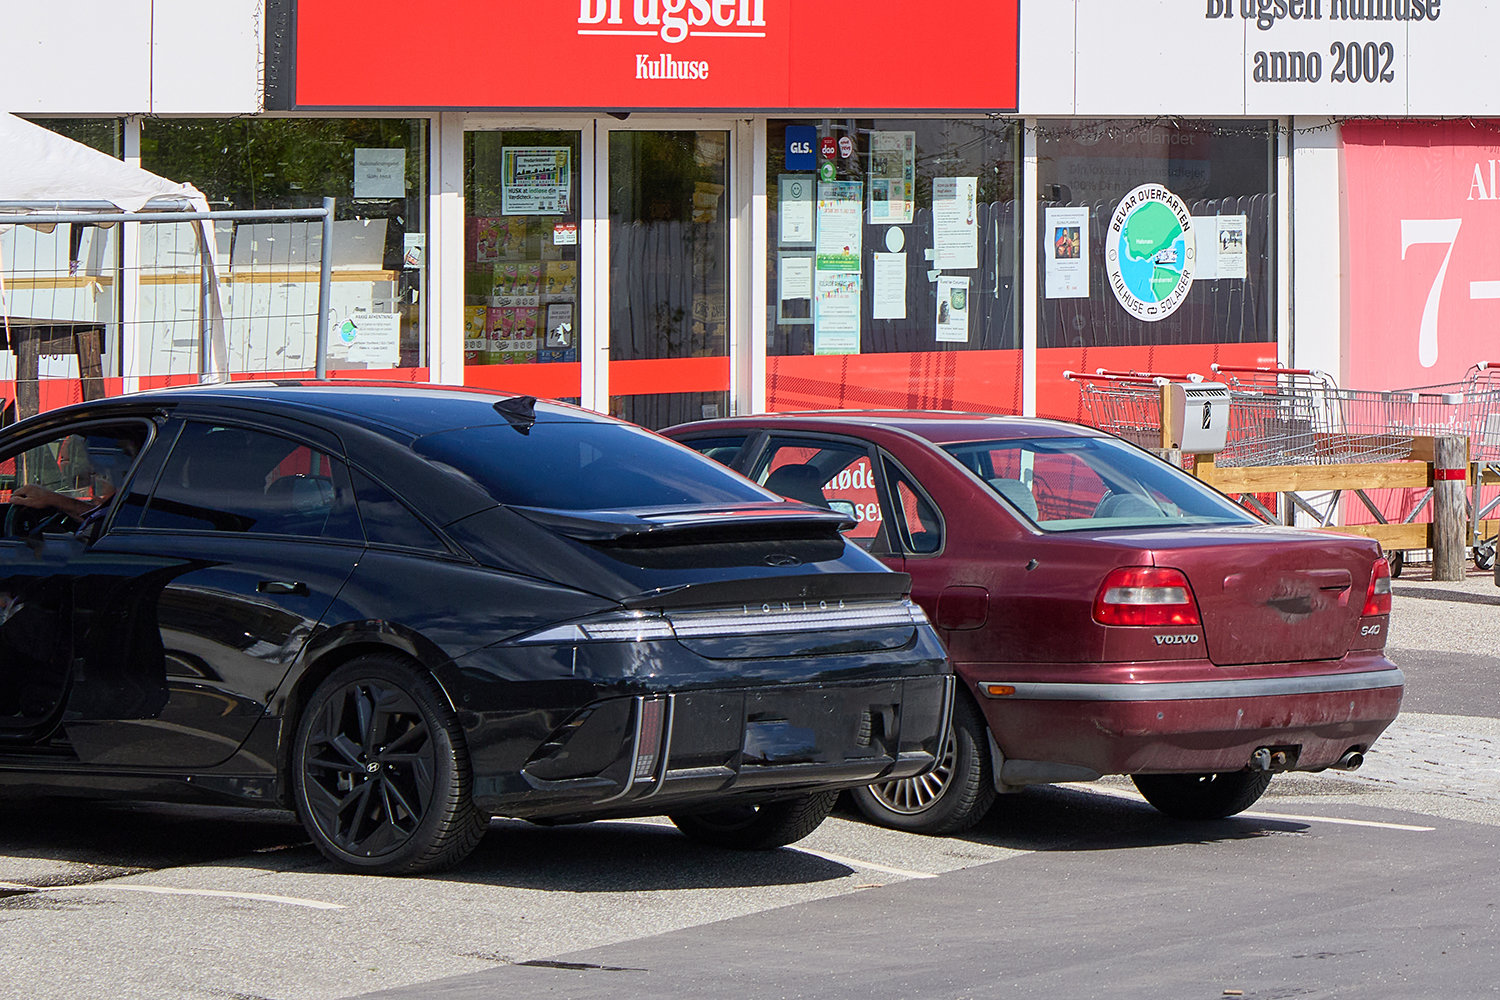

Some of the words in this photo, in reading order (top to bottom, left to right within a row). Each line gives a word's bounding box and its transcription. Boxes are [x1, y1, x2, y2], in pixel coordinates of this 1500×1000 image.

[636, 54, 709, 79] Kulhuse
[1253, 50, 1322, 83] anno
[1330, 41, 1395, 83] 2002
[1112, 195, 1136, 232] BEVAR
[1138, 188, 1190, 232] OVERFARTEN
[1111, 271, 1144, 314] KULHUSE
[1154, 633, 1199, 645] VOLVO
[1361, 624, 1380, 636] S40
